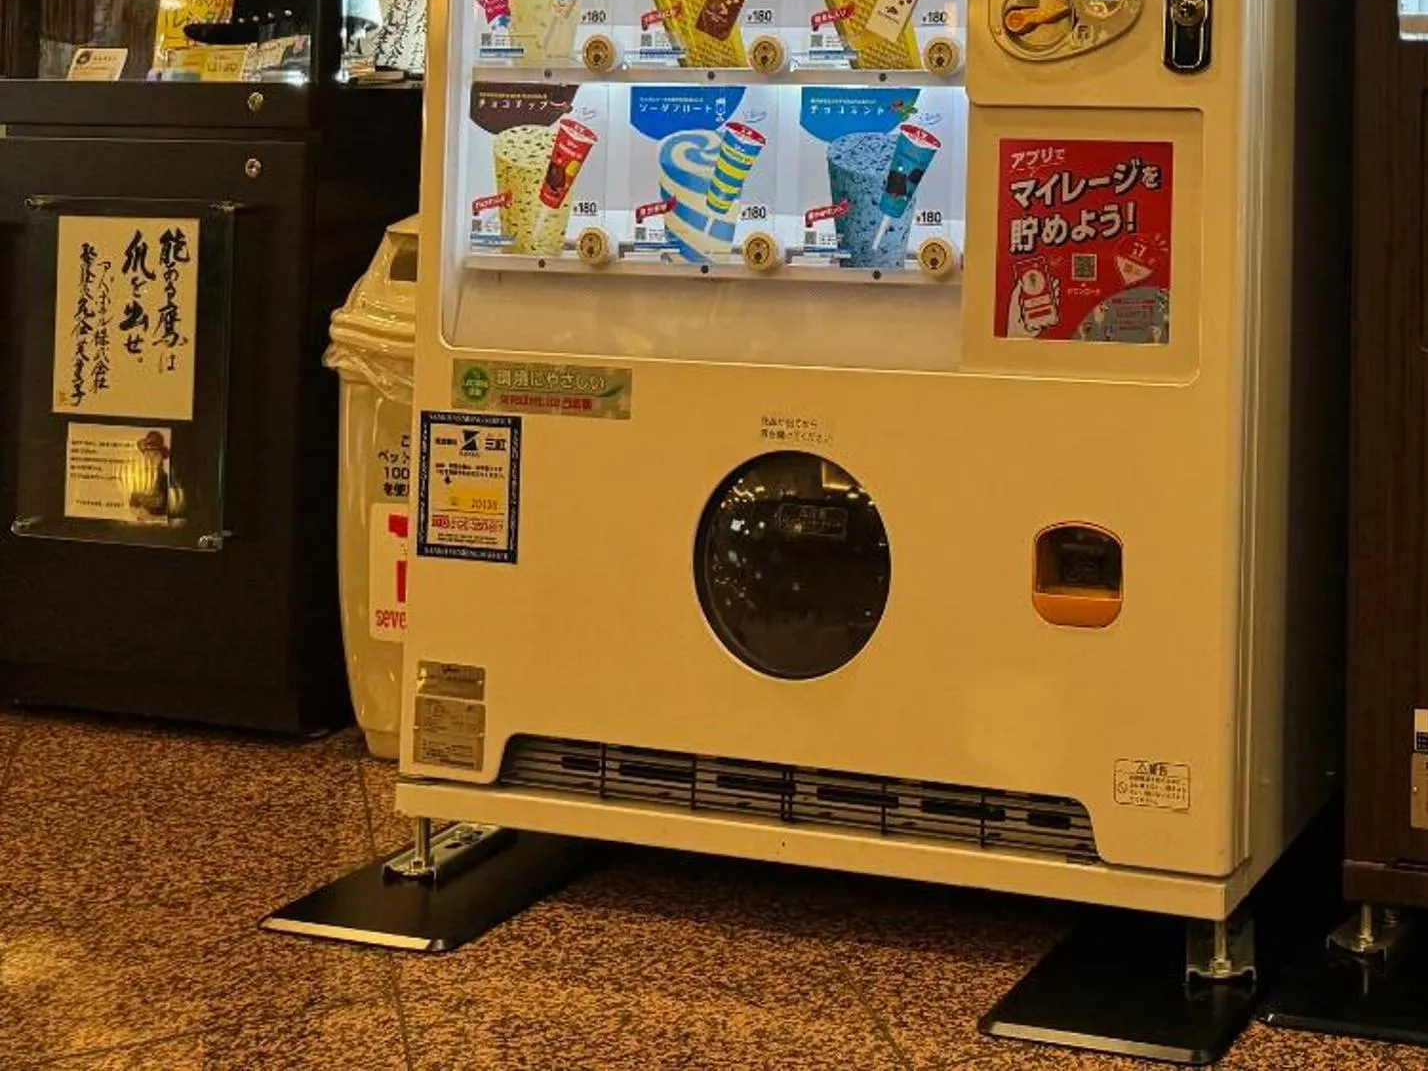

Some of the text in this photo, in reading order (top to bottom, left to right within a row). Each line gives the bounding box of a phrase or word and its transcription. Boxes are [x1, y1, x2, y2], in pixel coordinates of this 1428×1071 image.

[1010, 158, 1161, 210] マイレージを
[1009, 202, 1137, 254] 貯めよう!
